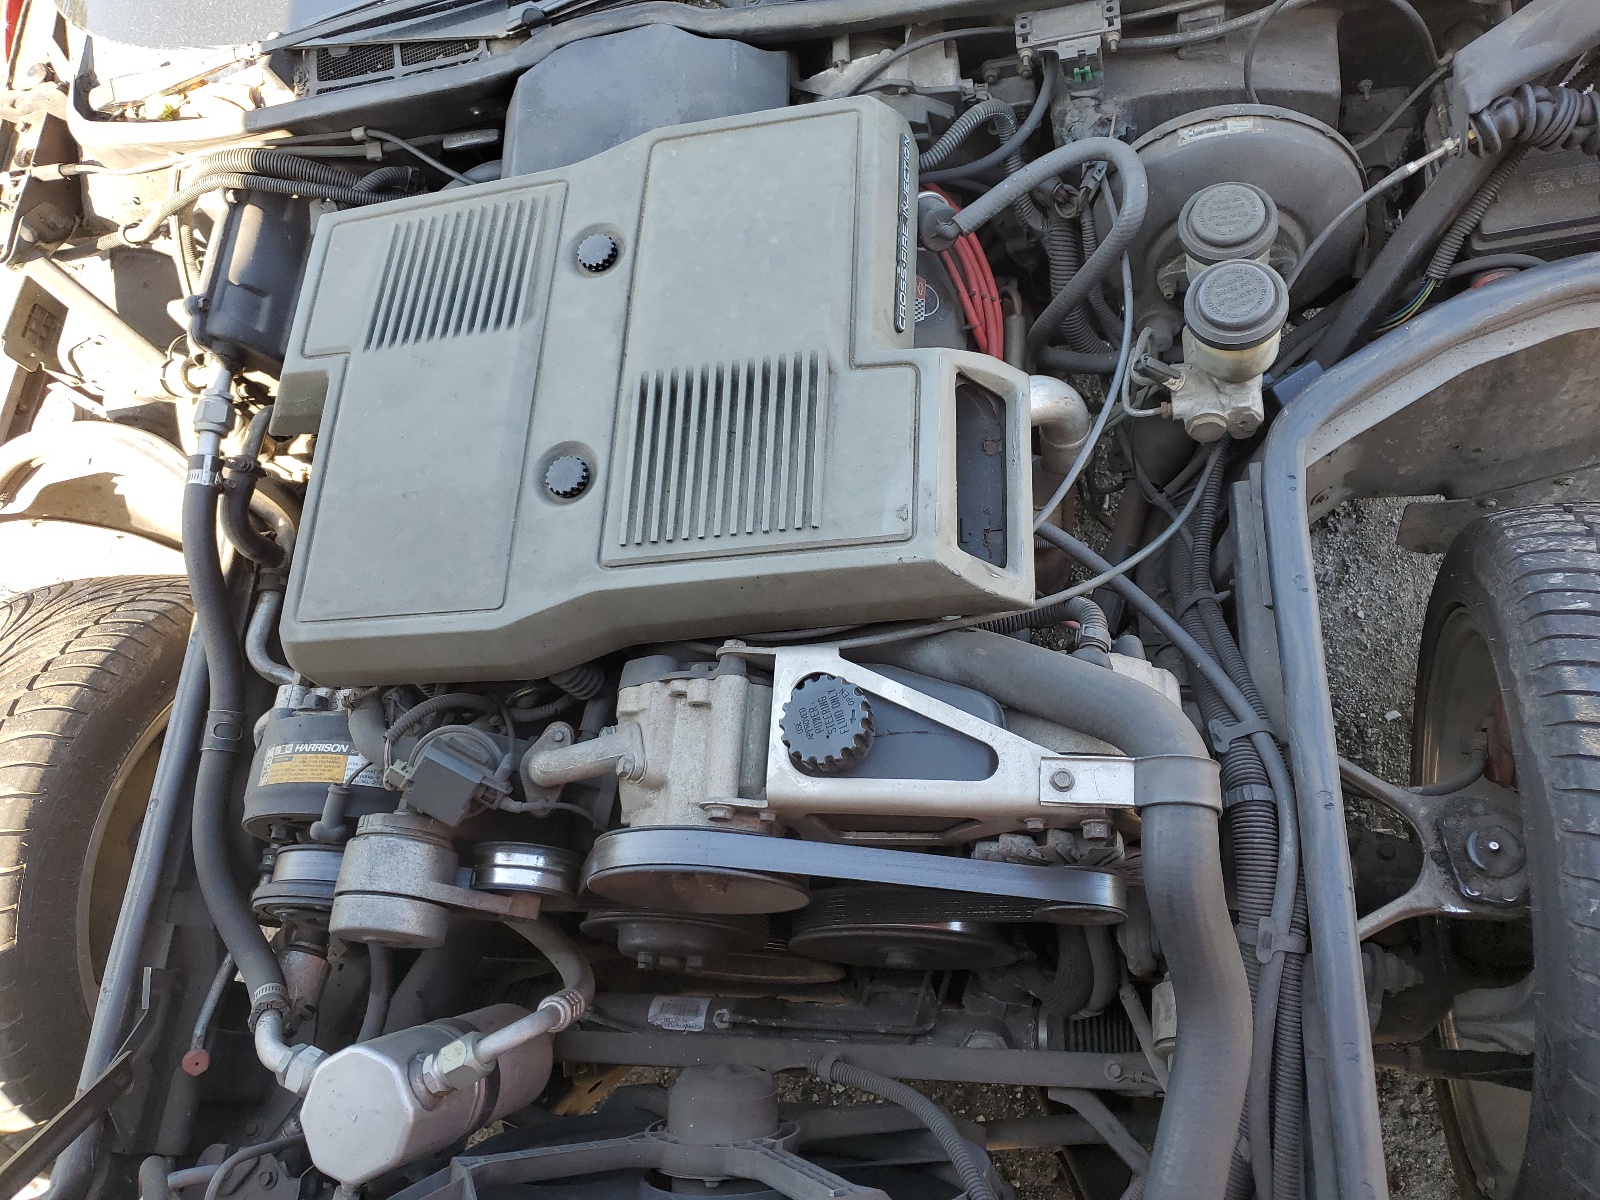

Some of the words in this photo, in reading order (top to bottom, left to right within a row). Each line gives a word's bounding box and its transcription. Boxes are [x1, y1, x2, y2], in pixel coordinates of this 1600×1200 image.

[901, 134, 911, 219] INJECTION
[826, 688, 841, 709] ONLY
[839, 688, 855, 706] OPEN
[798, 707, 815, 740] APPROVED
[809, 705, 825, 735] POWER
[817, 695, 837, 735] STEERING
[833, 709, 850, 735] FLUID
[793, 722, 804, 735] USE
[294, 743, 350, 753] HARRISON
